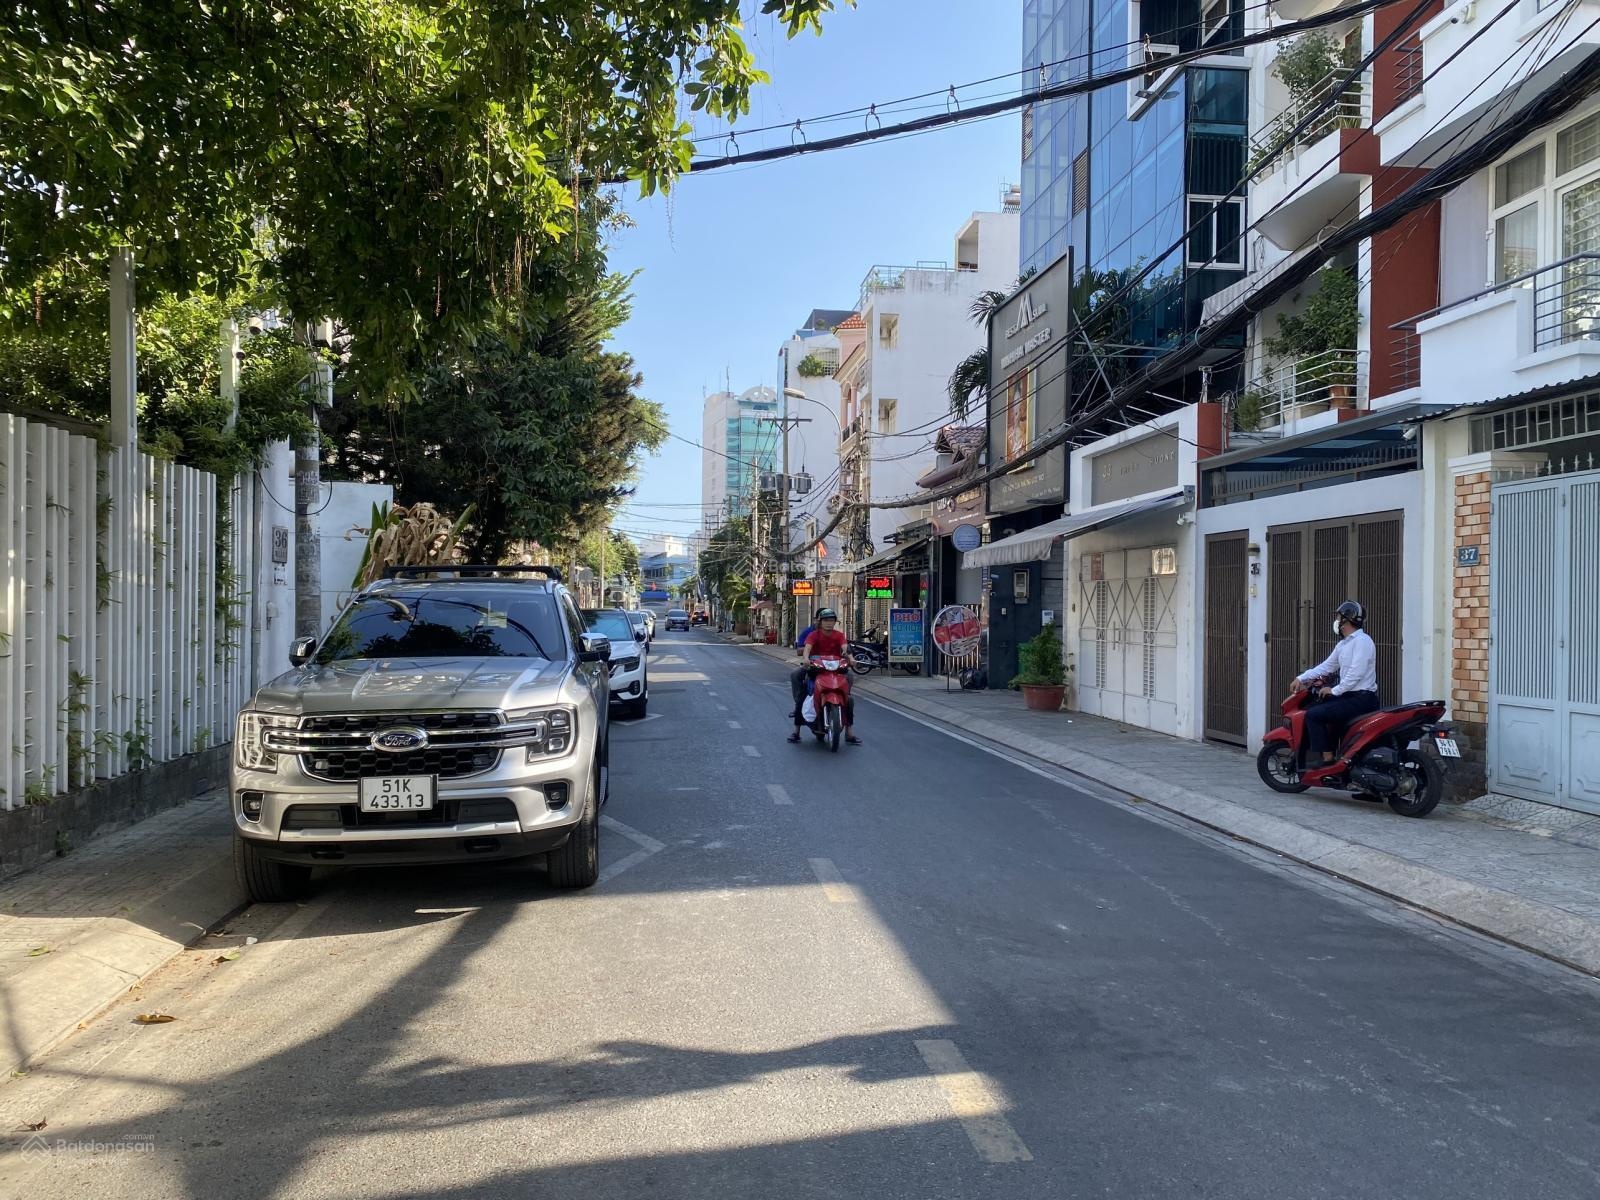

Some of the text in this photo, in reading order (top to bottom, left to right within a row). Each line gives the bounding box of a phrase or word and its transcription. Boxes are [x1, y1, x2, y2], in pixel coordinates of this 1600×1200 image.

[274, 530, 288, 549] 36
[1460, 548, 1476, 561] 37
[1250, 562, 1261, 576] 35
[384, 735, 412, 747] Ford
[382, 778, 411, 793] 51K
[370, 794, 424, 809] 433.13
